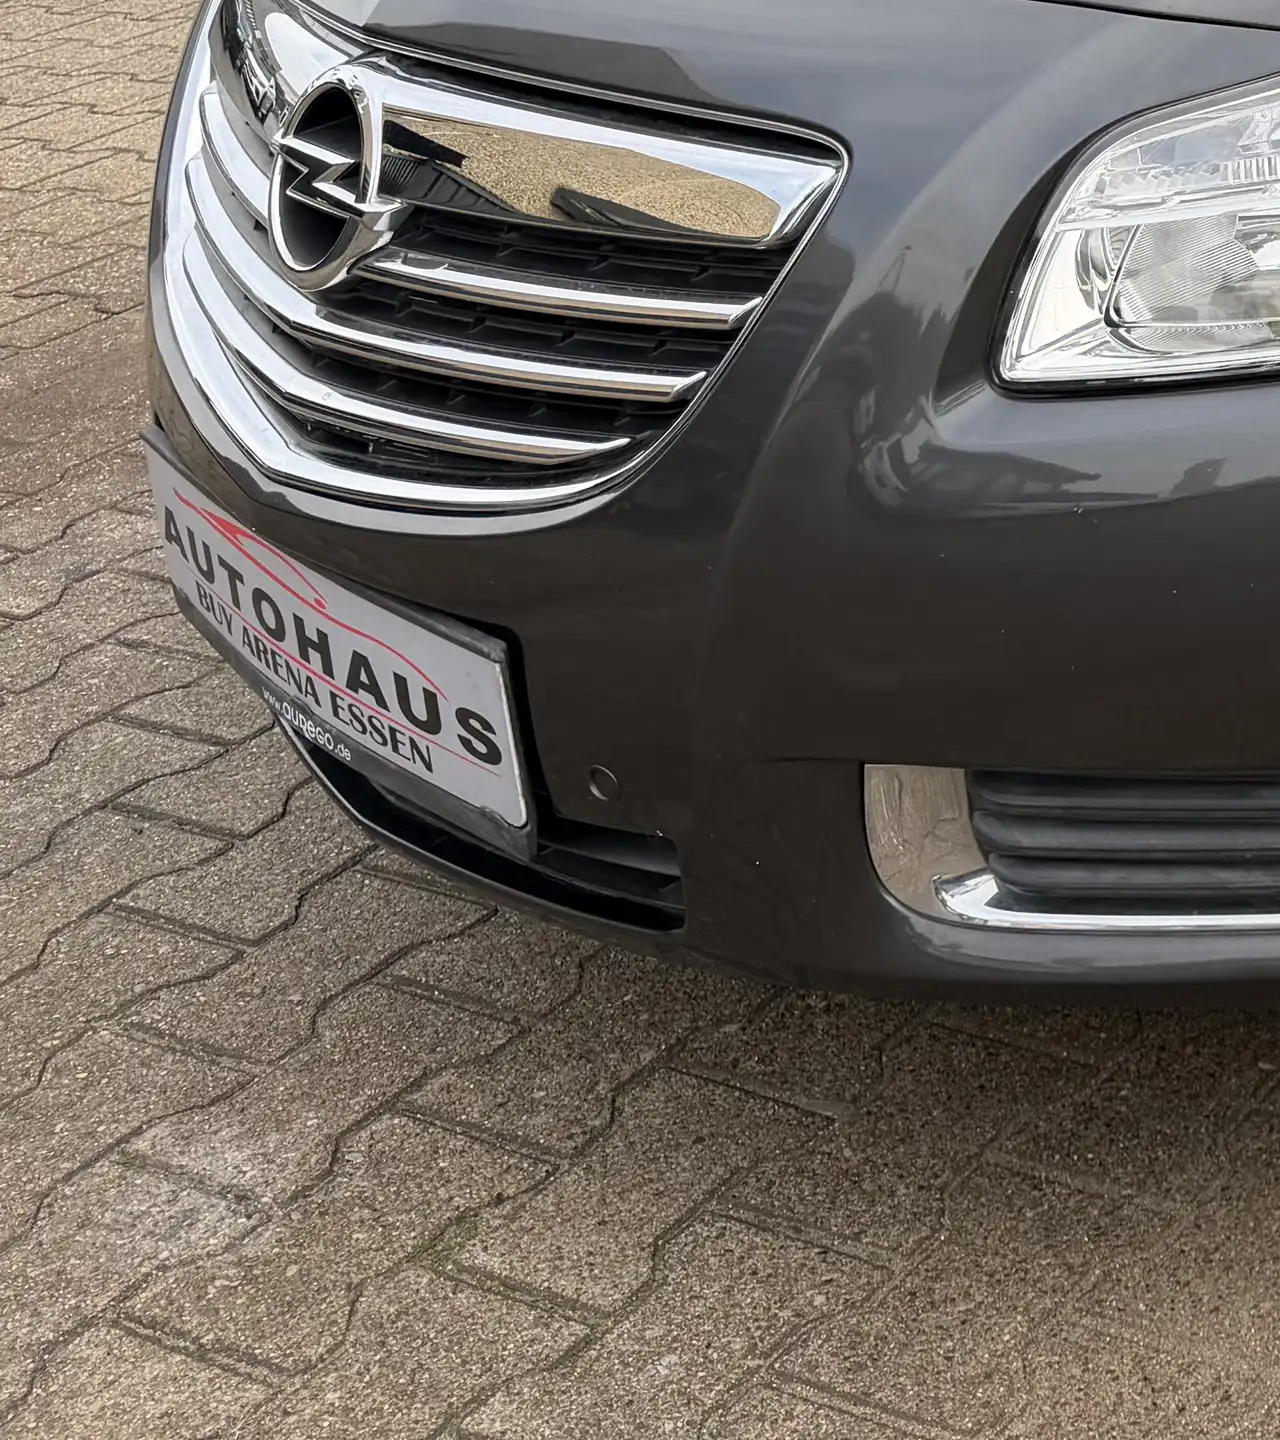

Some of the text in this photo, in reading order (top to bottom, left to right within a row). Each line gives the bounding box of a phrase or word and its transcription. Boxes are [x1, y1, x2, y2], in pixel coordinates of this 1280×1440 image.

[164, 505, 504, 768] AUTOHAUS
[196, 580, 435, 775] BUY ARENA ESSEN
